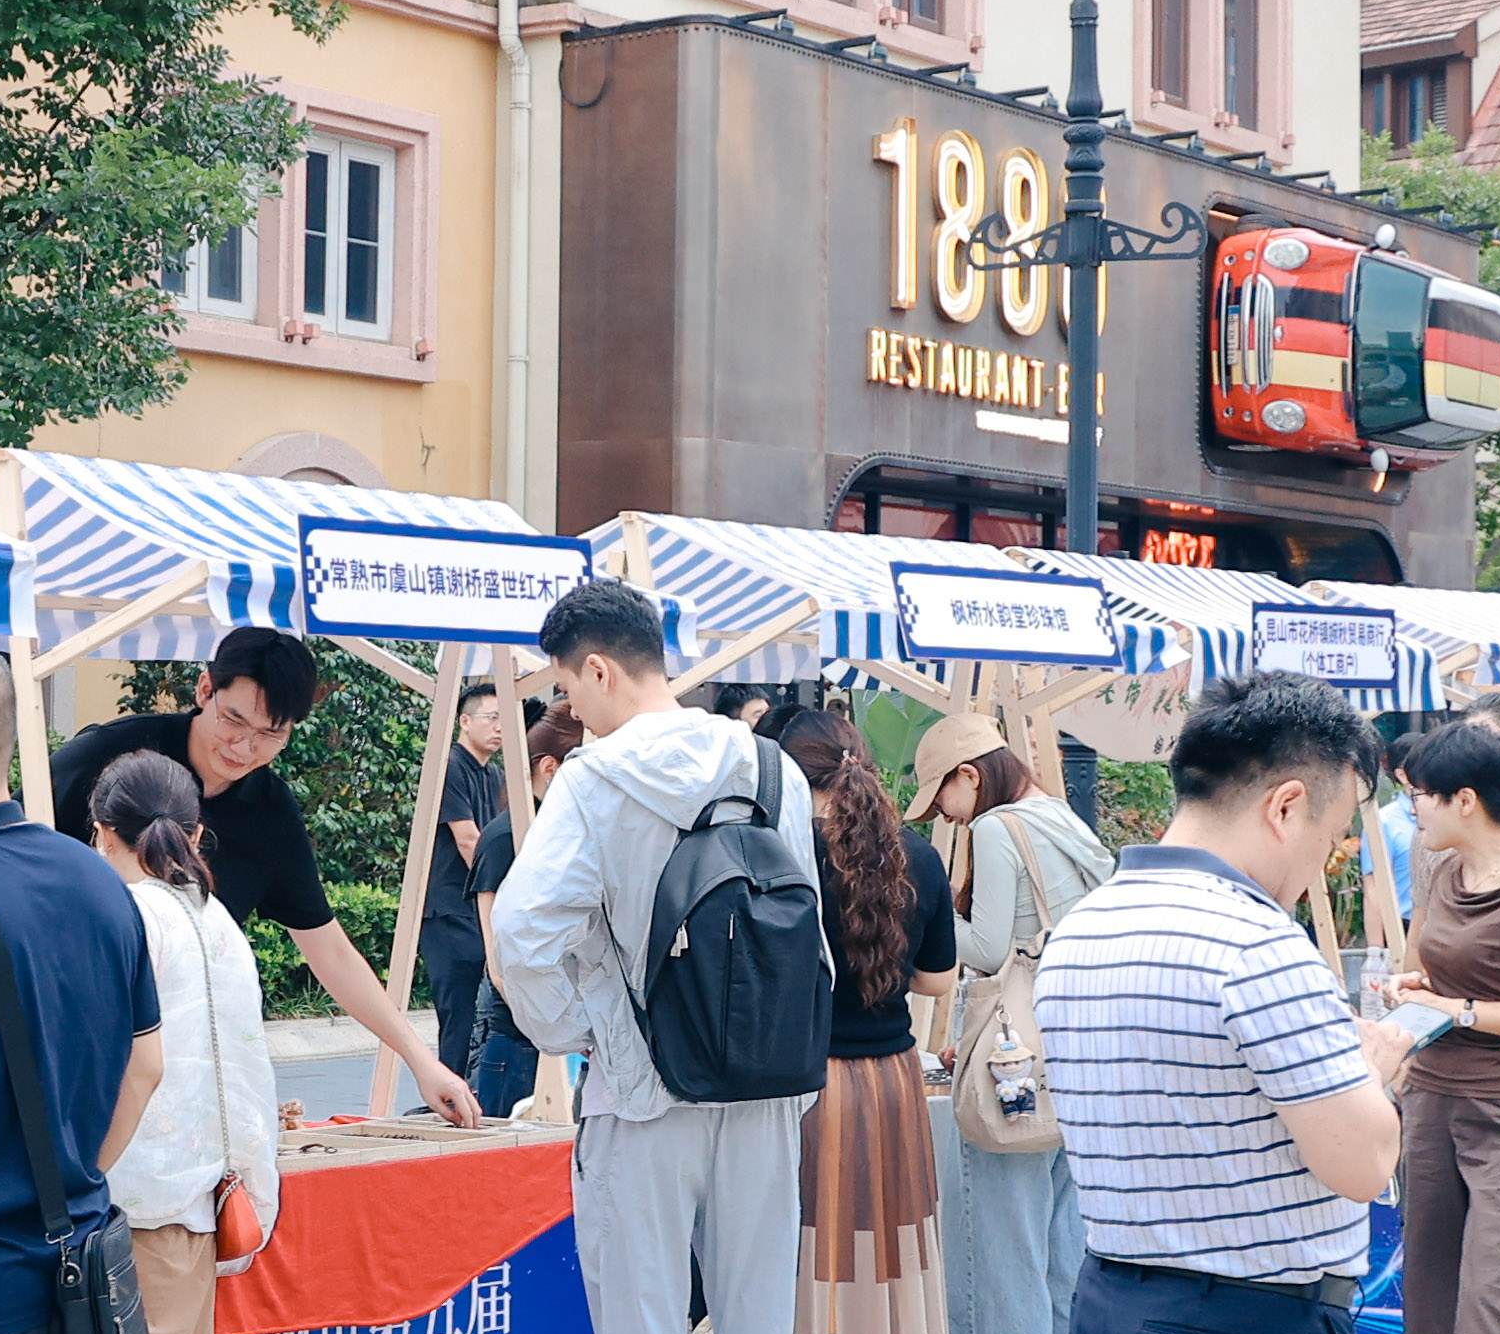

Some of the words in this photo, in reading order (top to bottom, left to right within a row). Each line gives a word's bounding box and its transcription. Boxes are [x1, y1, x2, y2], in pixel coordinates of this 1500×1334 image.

[872, 117, 1107, 339] 188
[950, 598, 1071, 633] 枫桥水韵堂珍珠馆
